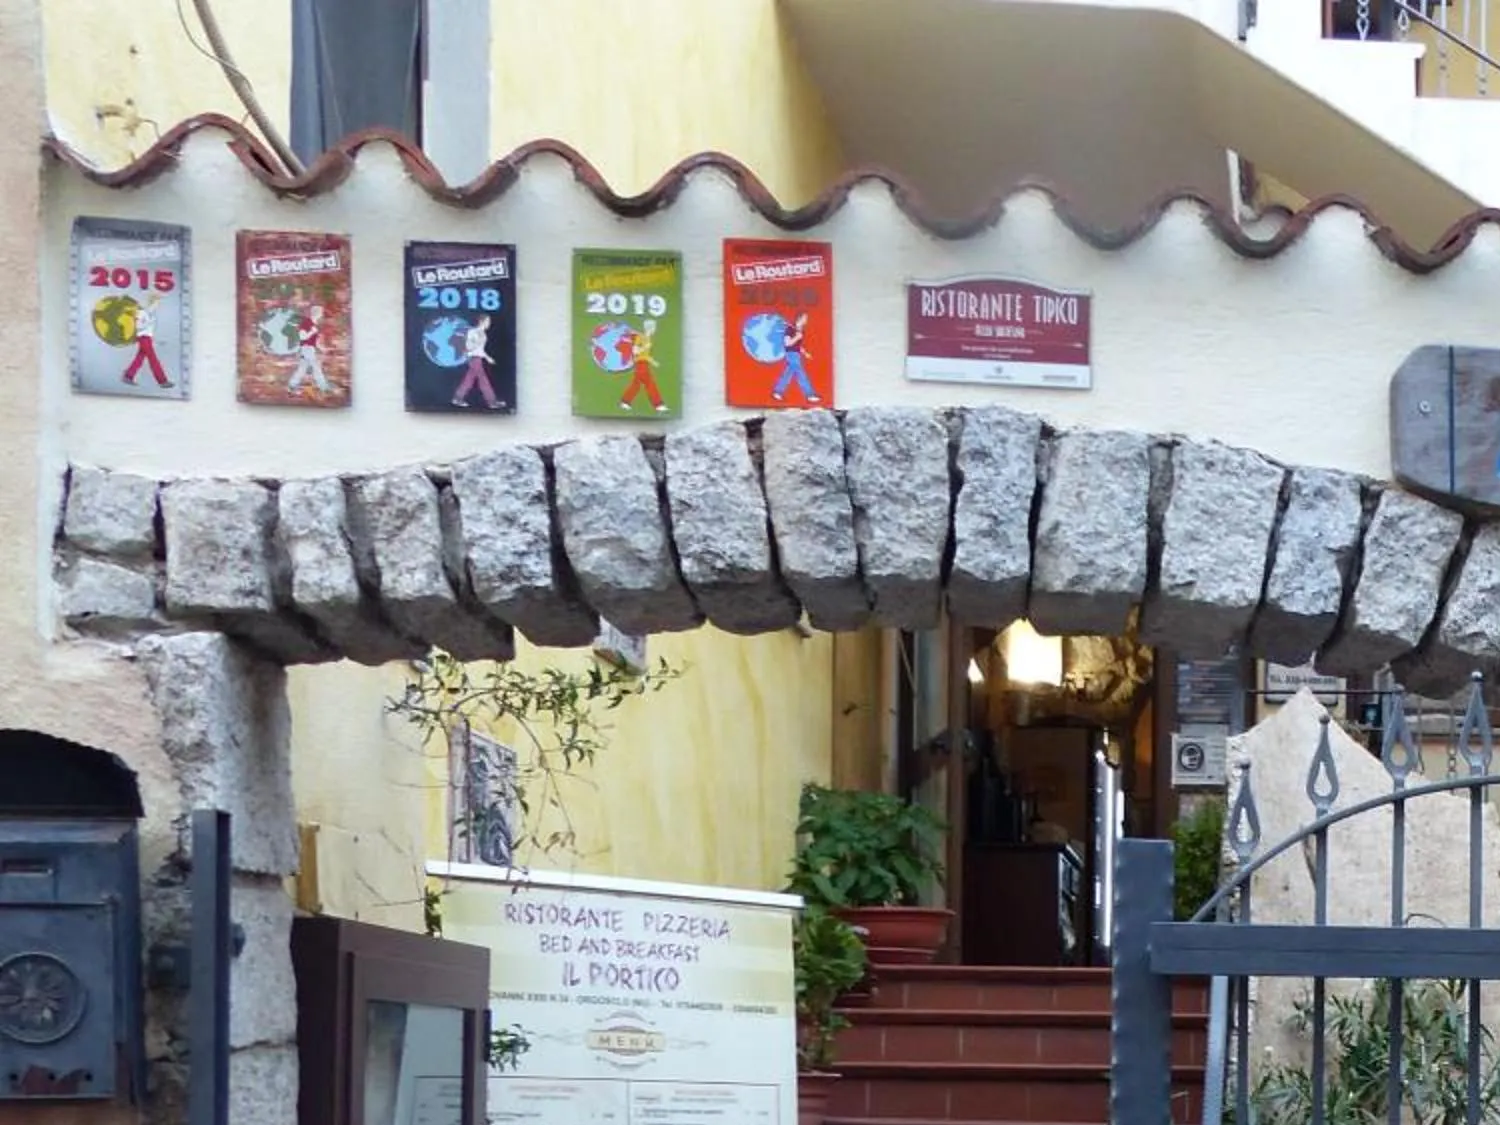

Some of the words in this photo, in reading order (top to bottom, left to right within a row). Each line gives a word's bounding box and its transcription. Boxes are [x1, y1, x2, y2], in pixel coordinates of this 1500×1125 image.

[271, 253, 337, 273] Routard
[416, 270, 436, 283] Le
[437, 261, 504, 281] Routard
[755, 260, 821, 278] Routard
[88, 266, 175, 292] 2015
[418, 286, 501, 311] 2018
[586, 291, 667, 316] 2019
[921, 288, 1023, 322] RISTORANTE
[1033, 294, 1079, 325] TIPICO
[504, 902, 625, 933] RISTORANTE
[642, 911, 731, 941] PIZZERIA
[539, 933, 573, 954] BED
[577, 935, 609, 957] AND
[615, 938, 701, 963] BREAKFAST
[561, 961, 581, 987] IL
[588, 962, 680, 993] PORTICO
